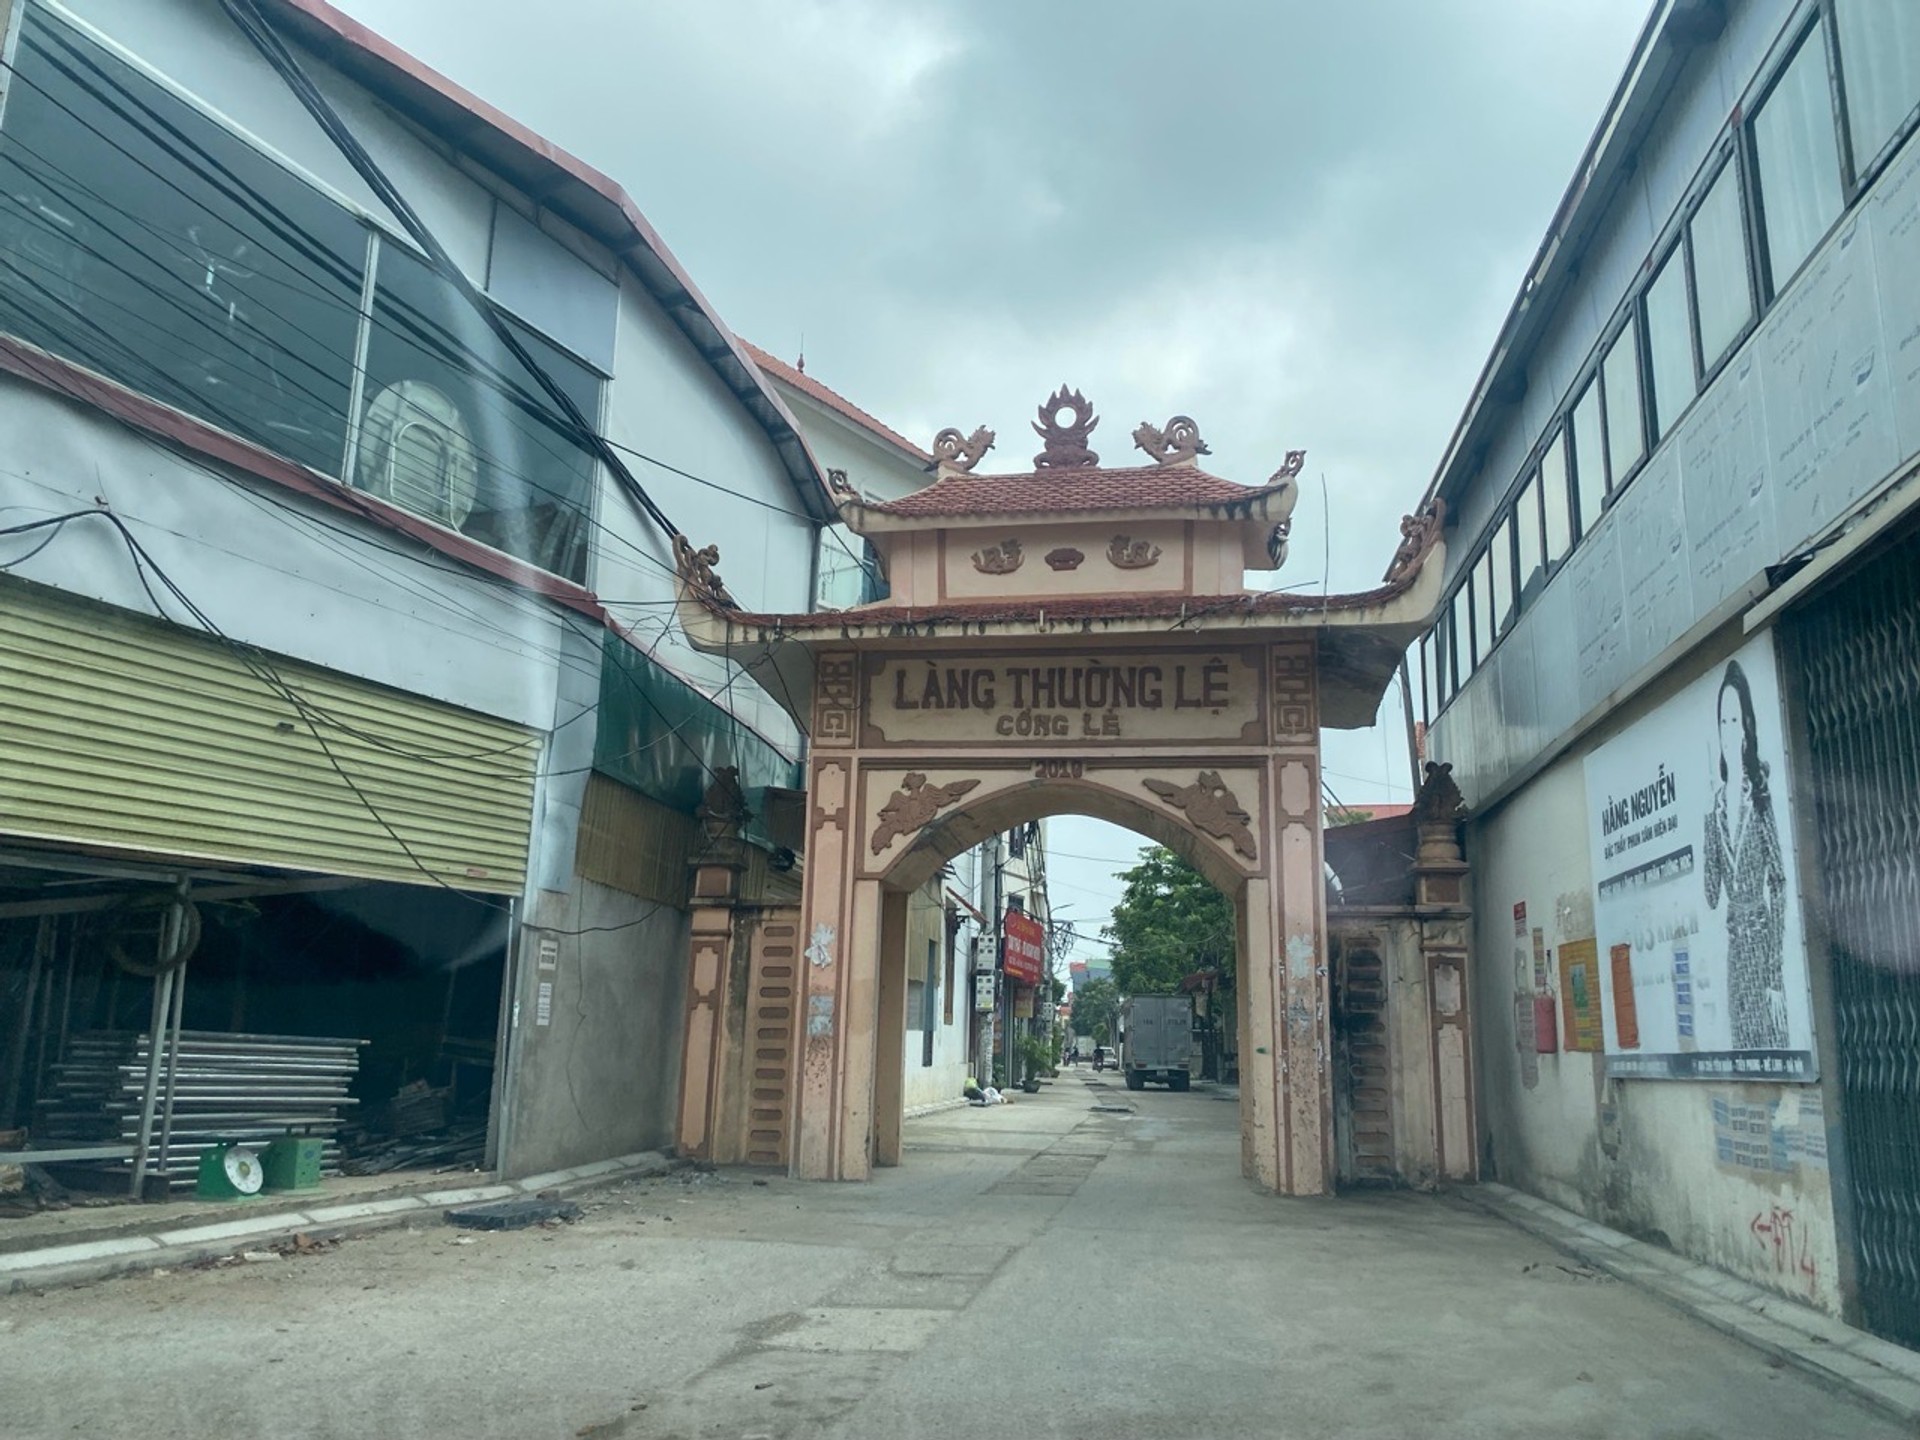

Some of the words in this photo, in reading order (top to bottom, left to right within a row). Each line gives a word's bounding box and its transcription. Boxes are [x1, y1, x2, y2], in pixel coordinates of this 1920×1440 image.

[895, 661, 996, 710] LÀNG
[1174, 656, 1230, 715] LỆ
[1630, 762, 1676, 822] NGUYỄN
